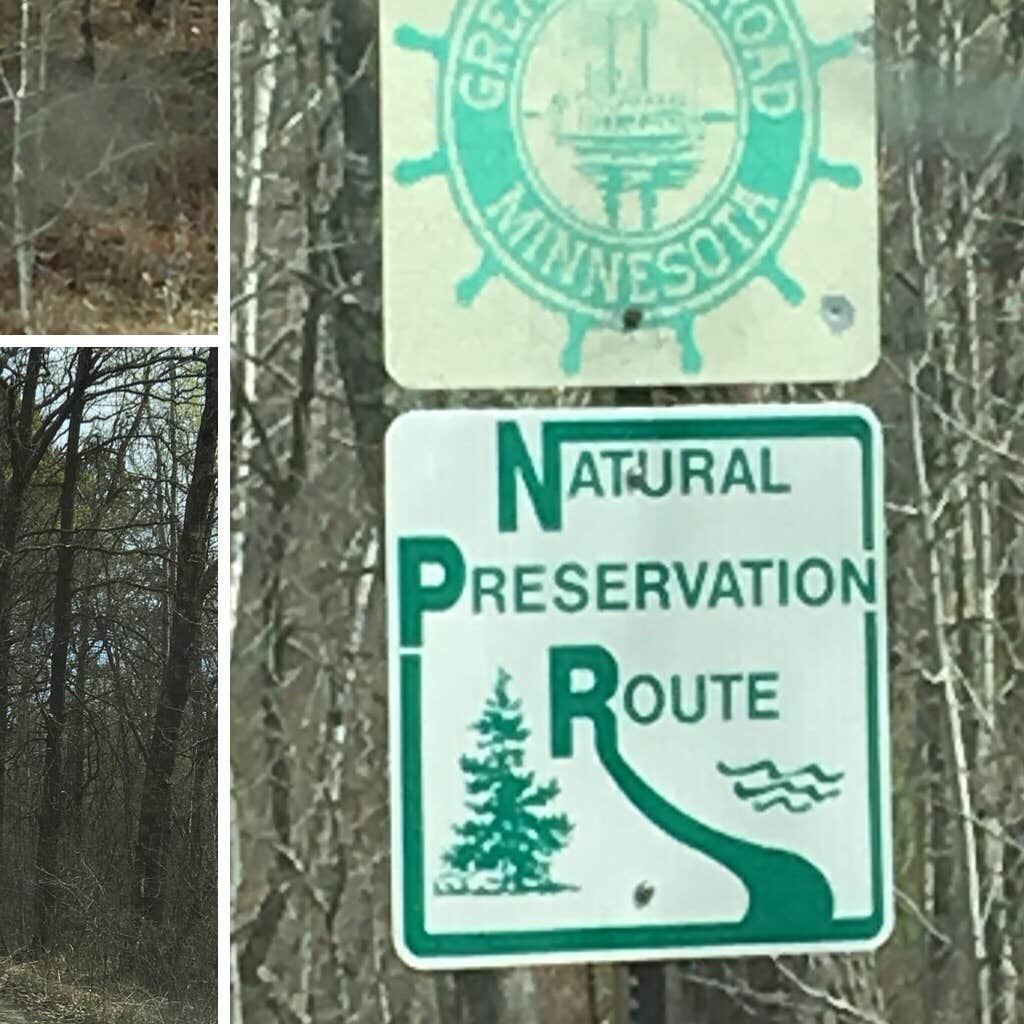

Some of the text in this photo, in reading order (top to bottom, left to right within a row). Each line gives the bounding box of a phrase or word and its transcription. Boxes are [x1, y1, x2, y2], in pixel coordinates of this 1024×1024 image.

[486, 183, 780, 304] MINNESOTA
[498, 421, 791, 532] NATURAL
[398, 536, 877, 648] PRESERVATION
[549, 644, 780, 759] ROUTE
